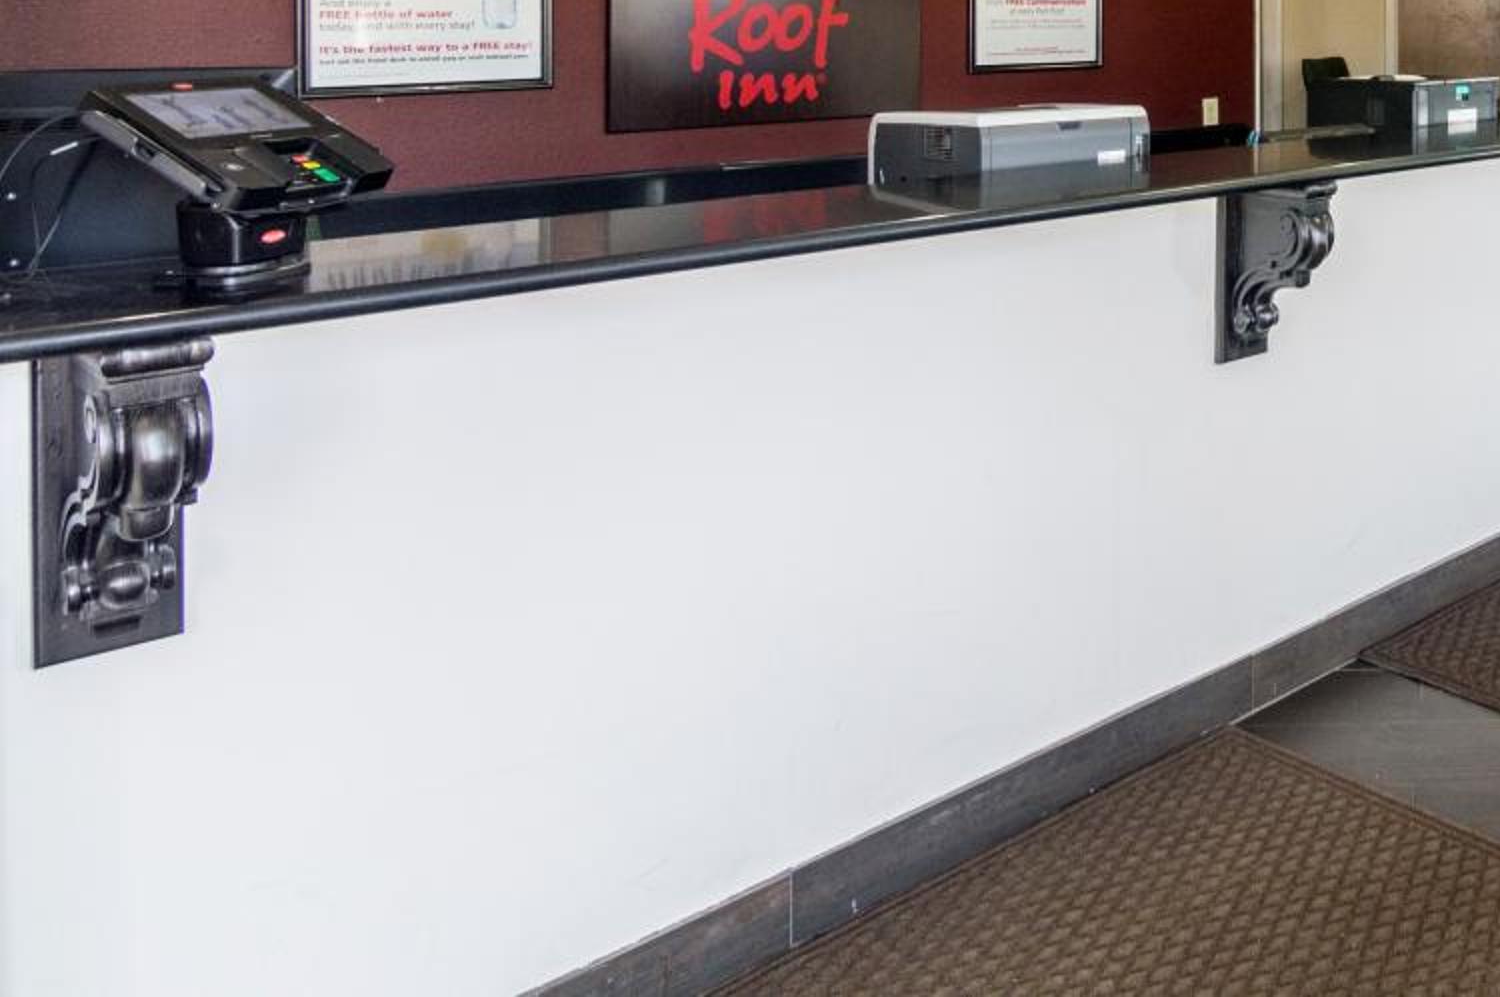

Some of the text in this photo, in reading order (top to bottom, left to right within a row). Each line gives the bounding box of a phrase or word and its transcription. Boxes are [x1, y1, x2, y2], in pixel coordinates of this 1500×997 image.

[319, 10, 350, 20] FREE
[353, 9, 395, 20] bttle
[415, 10, 453, 20] water
[359, 20, 383, 31] nd
[717, 69, 820, 110] Inn
